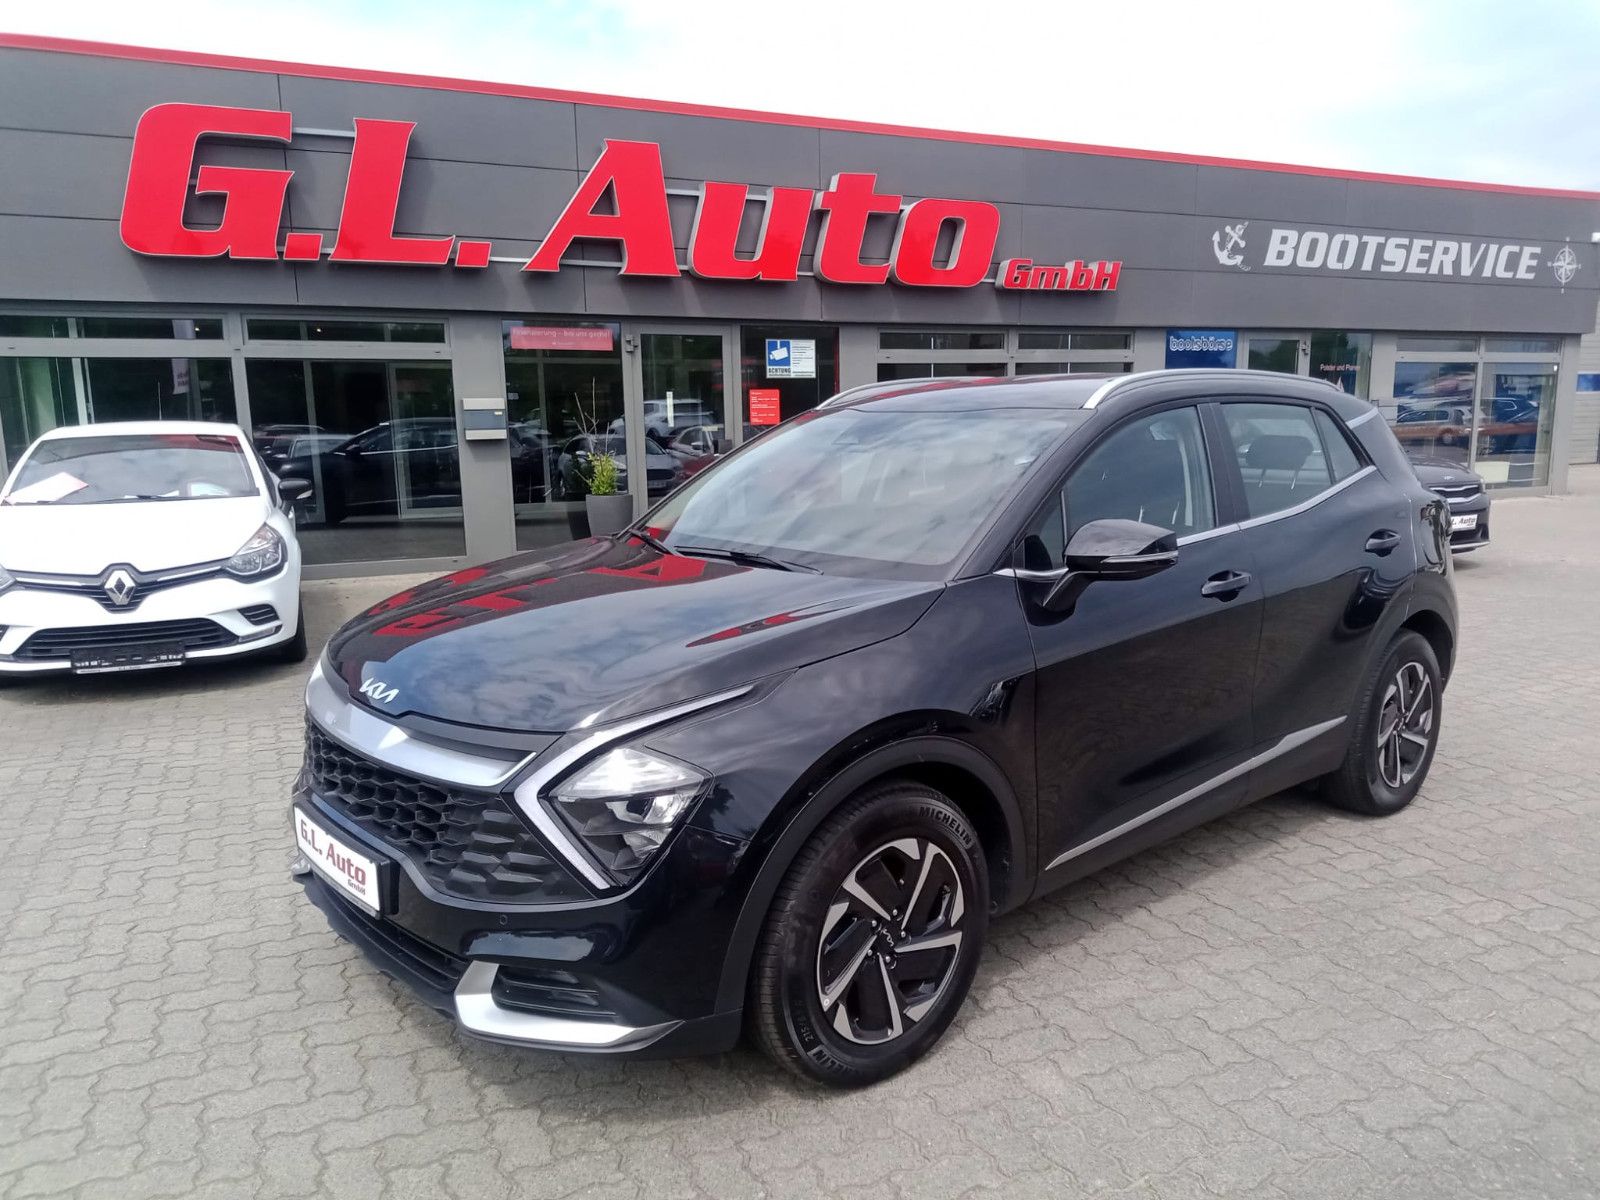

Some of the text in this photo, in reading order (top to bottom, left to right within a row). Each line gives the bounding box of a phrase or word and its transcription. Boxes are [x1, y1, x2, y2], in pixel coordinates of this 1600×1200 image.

[119, 102, 1123, 292] G.L. Auto GmbH
[1263, 228, 1542, 280] BOOTSERVICE
[1459, 516, 1477, 525] Auto
[359, 677, 400, 704] KIA
[918, 805, 973, 846] MICHELIN
[300, 817, 367, 887] G.L. Auto
